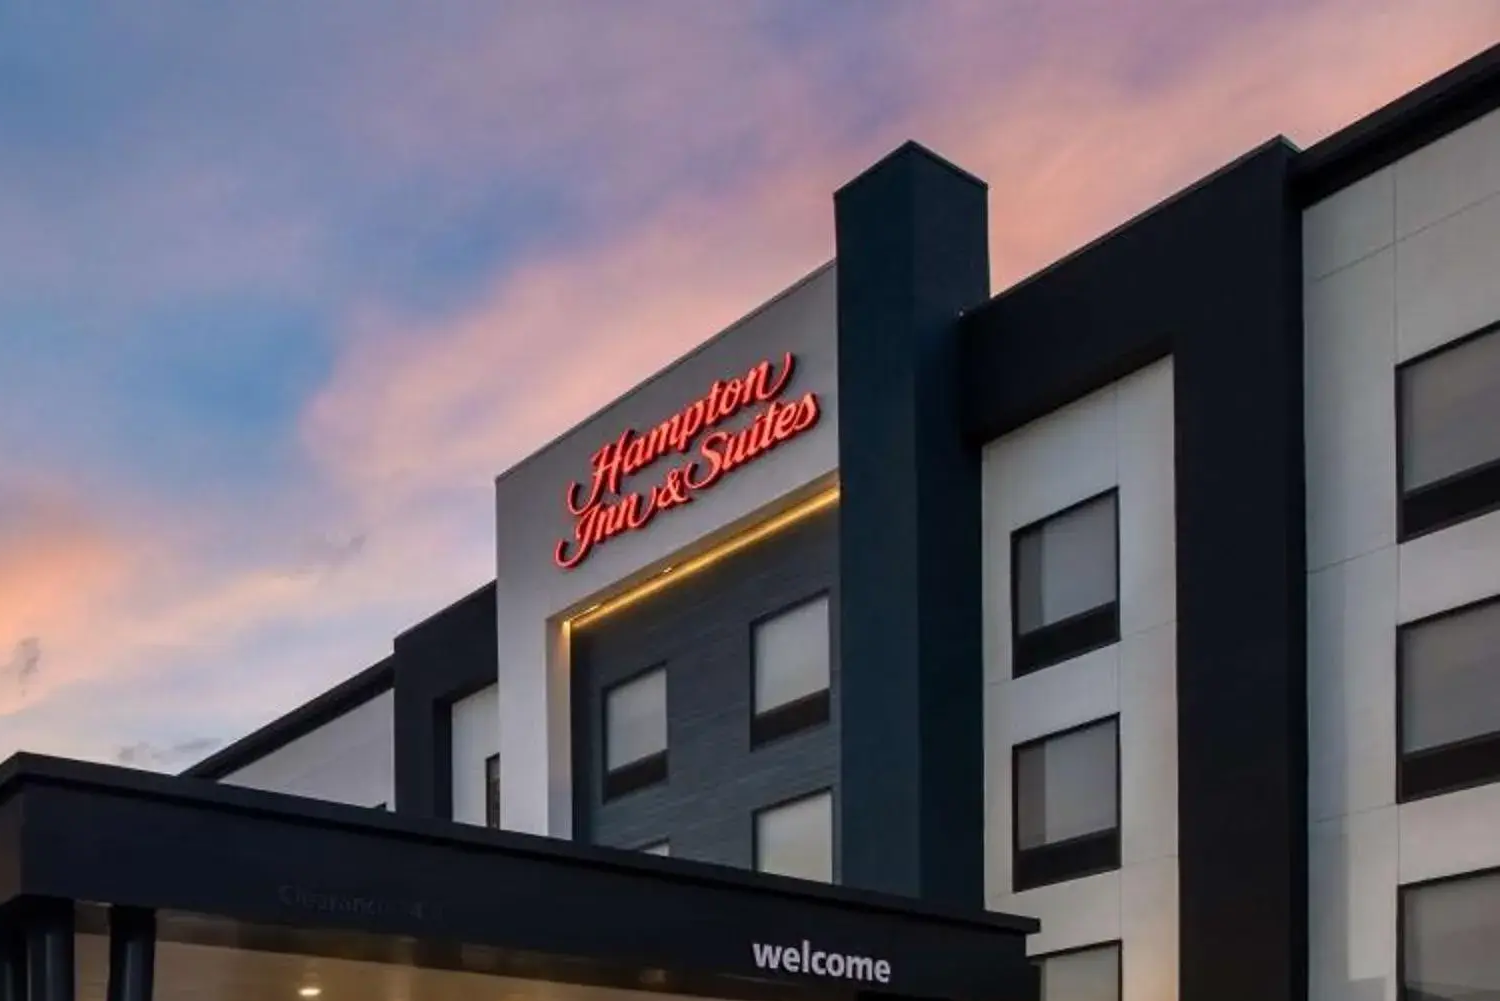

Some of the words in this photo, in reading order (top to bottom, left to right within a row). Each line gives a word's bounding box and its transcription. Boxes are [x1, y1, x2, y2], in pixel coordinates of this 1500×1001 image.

[555, 485, 658, 569] Inn
[657, 467, 694, 509] &
[683, 392, 821, 490] Suites
[567, 352, 795, 515] Hampton
[752, 939, 891, 983] welcome
